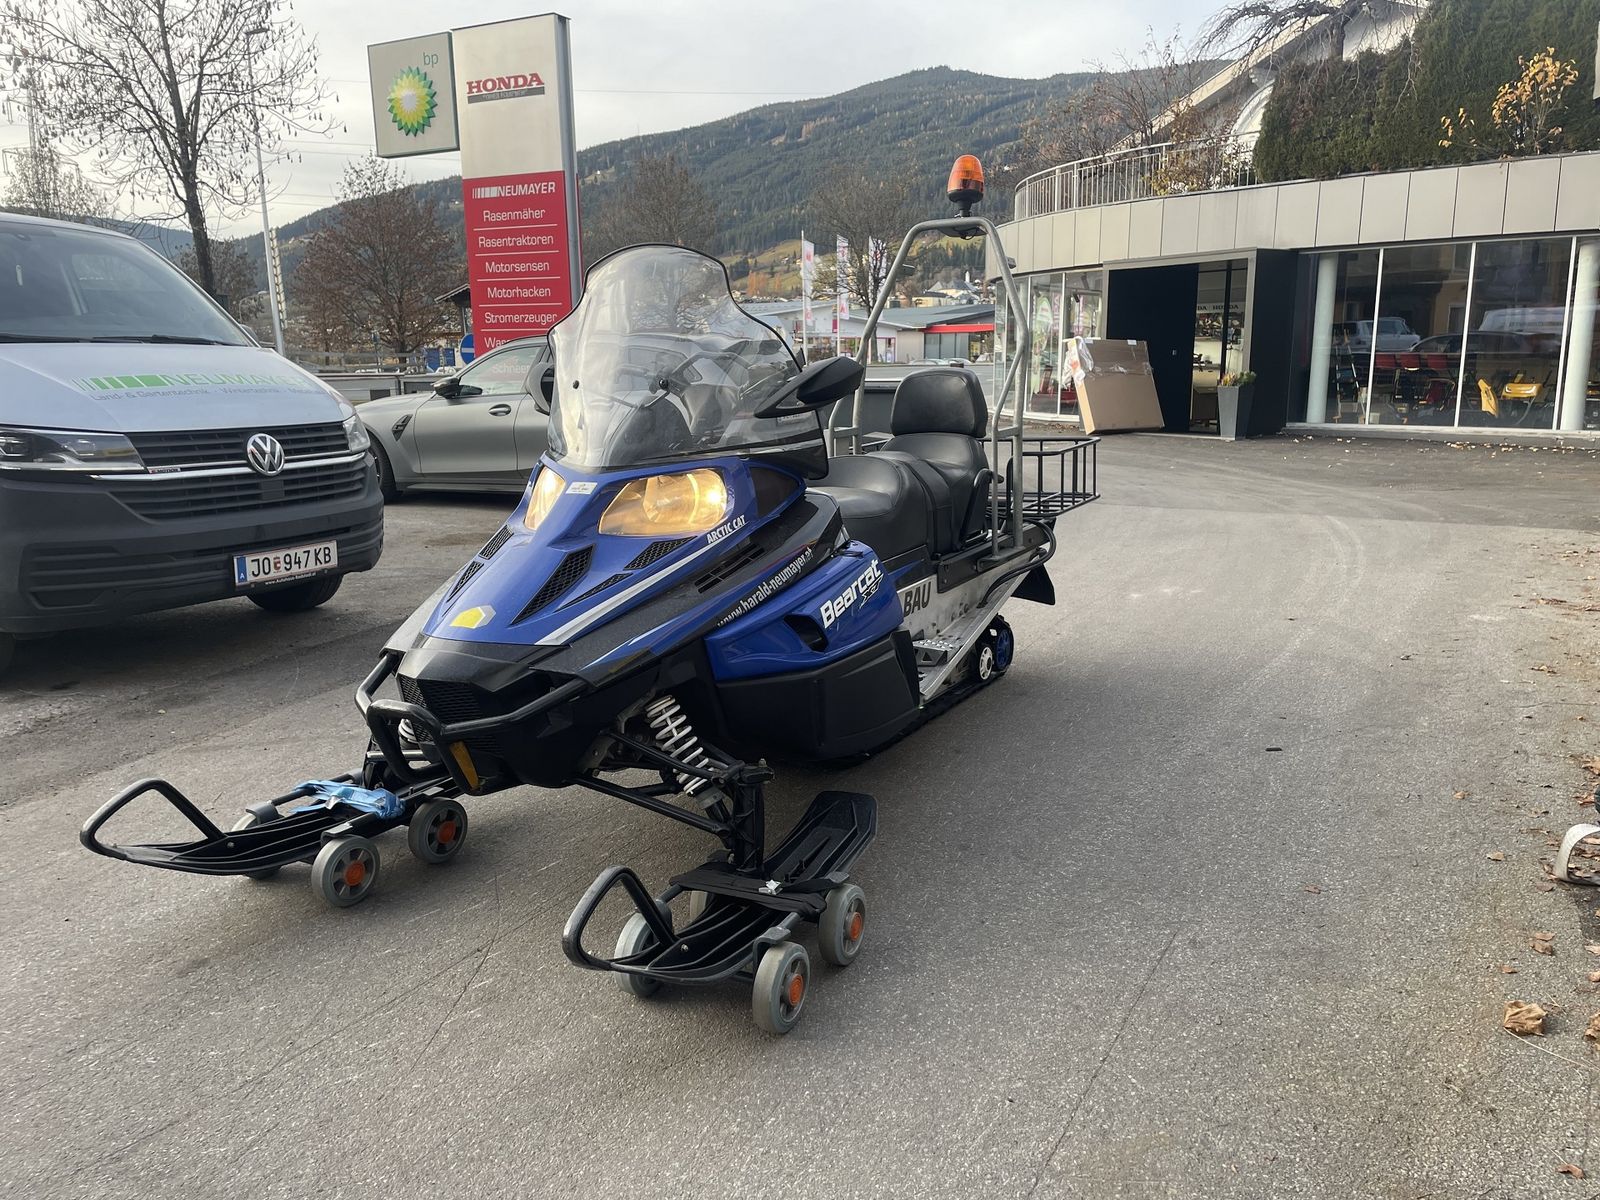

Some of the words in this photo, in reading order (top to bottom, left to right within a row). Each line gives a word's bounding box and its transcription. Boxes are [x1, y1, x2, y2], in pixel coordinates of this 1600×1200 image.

[423, 51, 438, 68] bp
[466, 72, 544, 94] HONDA
[498, 181, 556, 197] NEUMAYER
[483, 207, 545, 222] Rasenmäher
[478, 234, 554, 248] Rasentraktoren
[485, 261, 549, 273] Motorsensen
[487, 286, 551, 298] Motorhacken
[484, 311, 557, 325] Stromerzeuger
[706, 522, 733, 544] ARCTIC
[732, 514, 746, 529] CAT
[251, 557, 271, 577] JO
[283, 550, 311, 571] 947
[314, 547, 331, 566] KB
[820, 559, 882, 629] Bearcat
[904, 581, 932, 618] BAU
